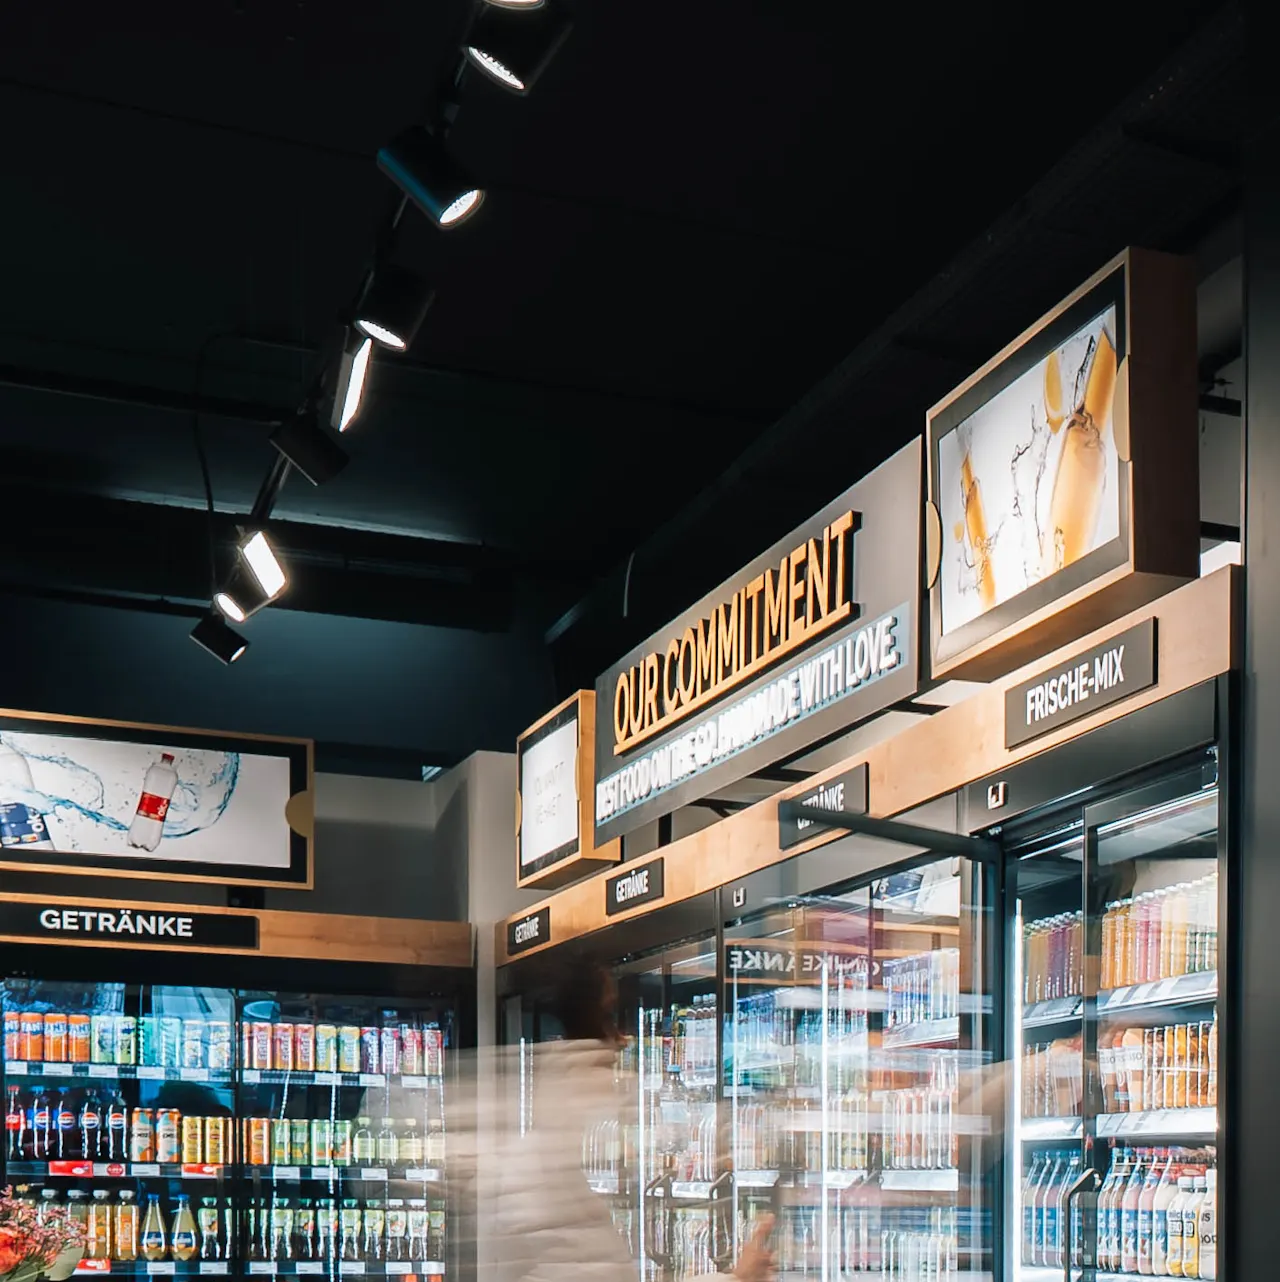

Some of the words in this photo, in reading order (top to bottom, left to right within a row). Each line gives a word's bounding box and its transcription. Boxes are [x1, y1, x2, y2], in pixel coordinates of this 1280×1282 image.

[614, 653, 659, 744] OUR
[664, 510, 855, 714] COMMITMENT
[620, 758, 651, 806] FOOD
[799, 645, 843, 709] WITH
[846, 616, 899, 686] LOVE.
[1026, 644, 1125, 724] FRISCHE-MIX
[40, 908, 194, 938] GETRÄNKE
[616, 870, 649, 903] GETRÄNKE
